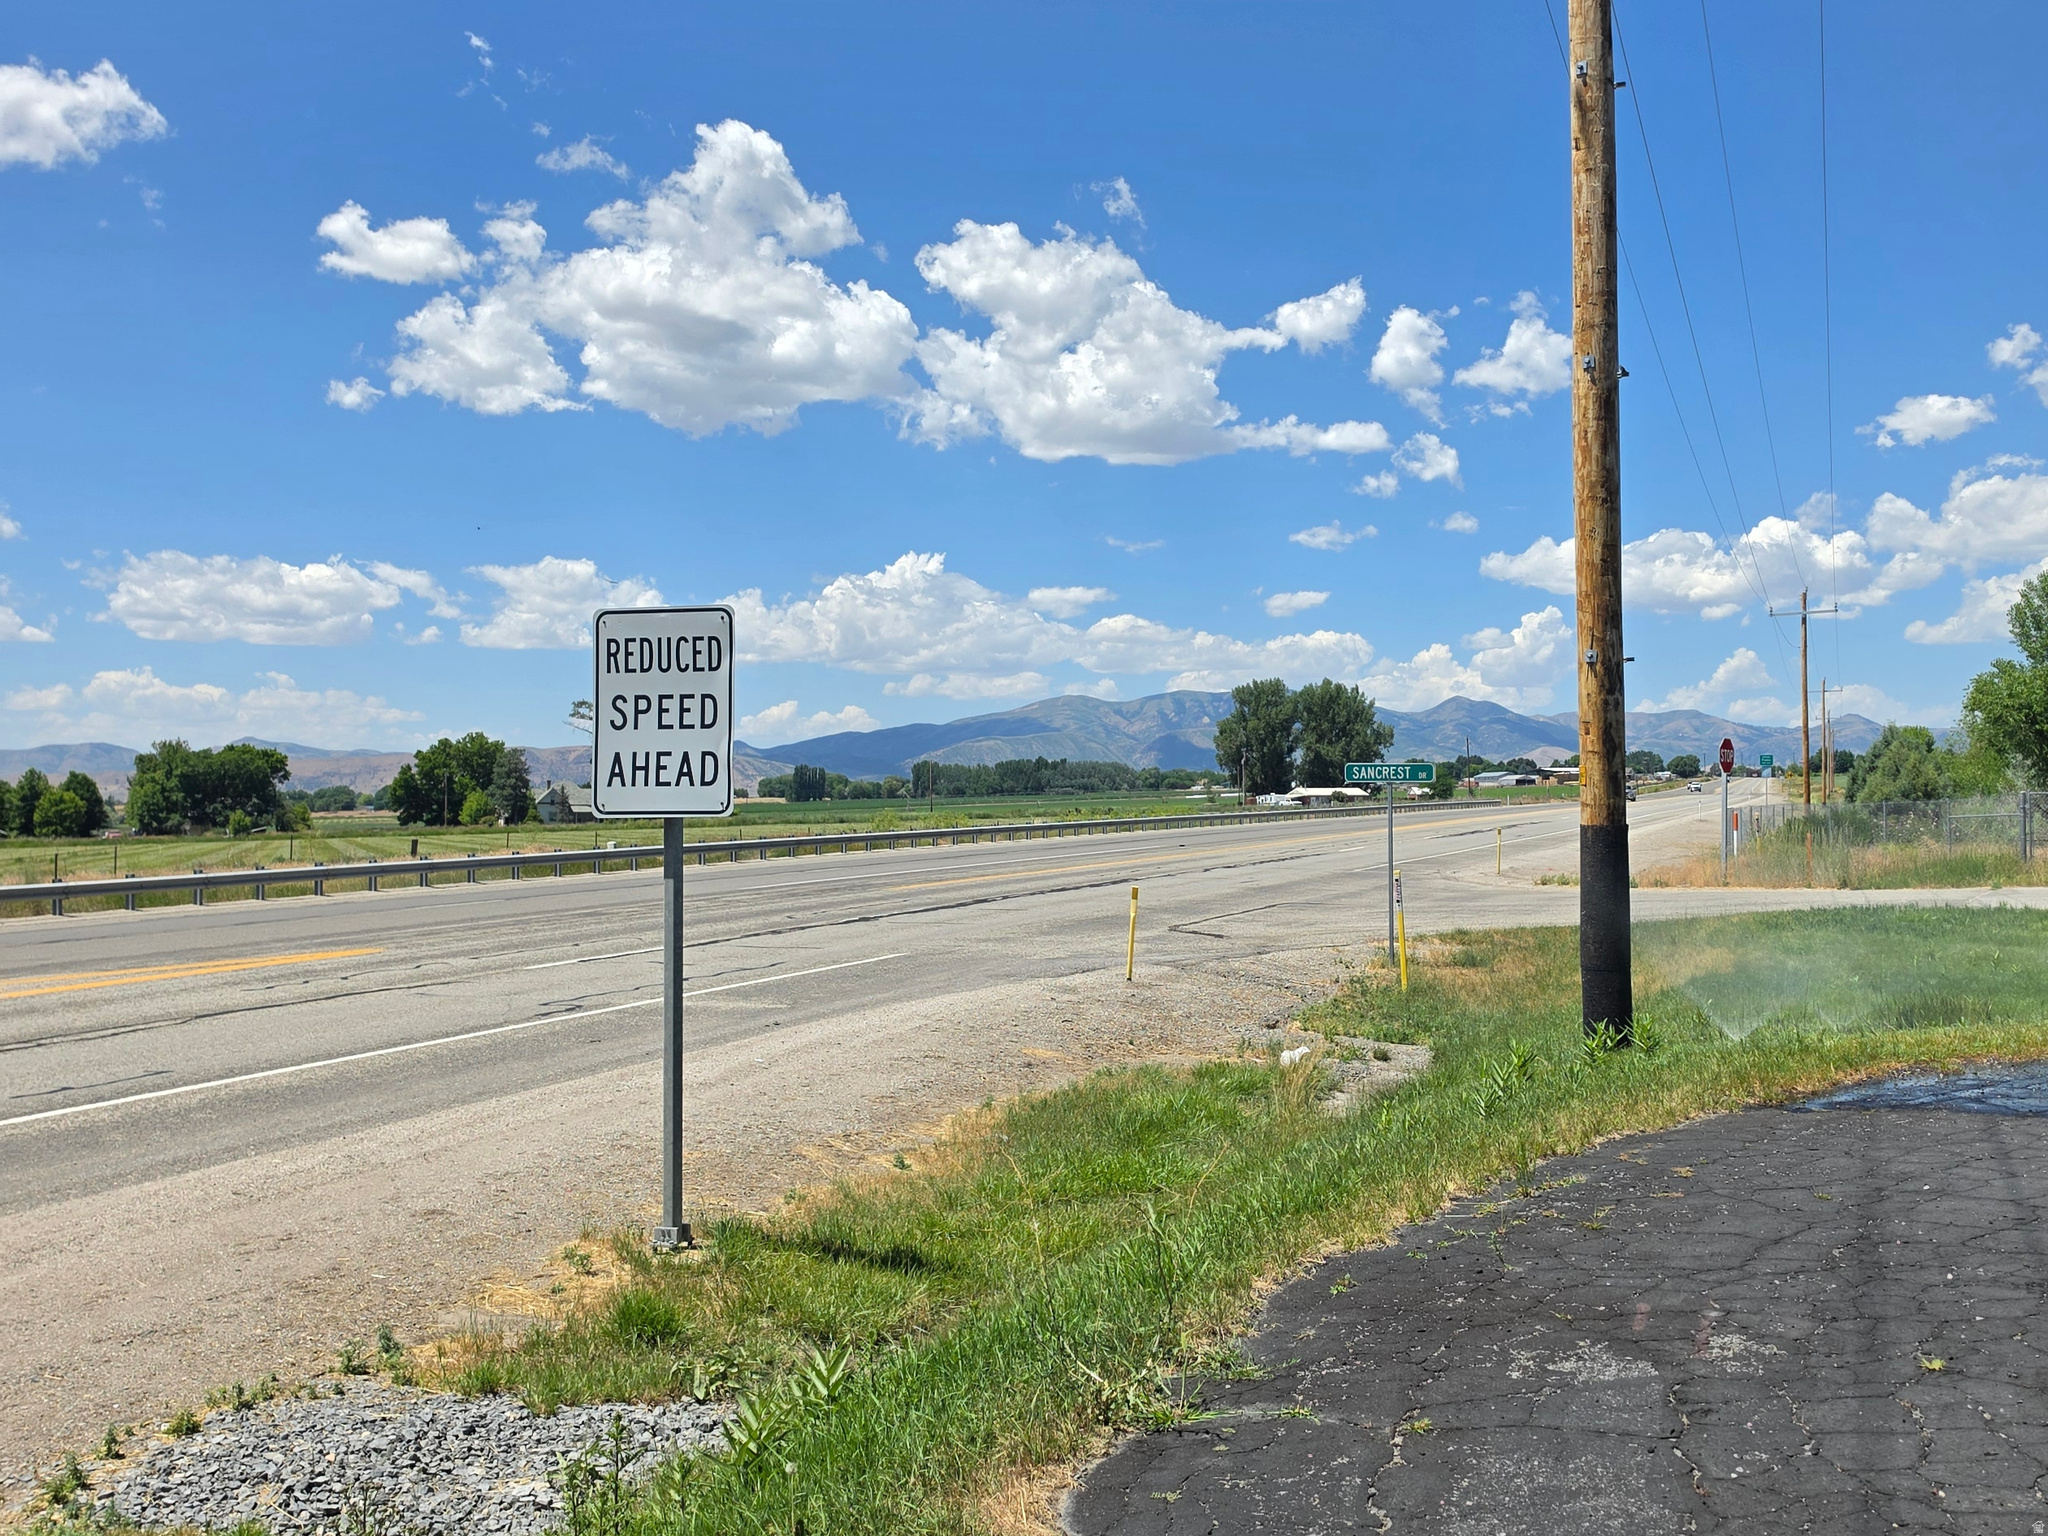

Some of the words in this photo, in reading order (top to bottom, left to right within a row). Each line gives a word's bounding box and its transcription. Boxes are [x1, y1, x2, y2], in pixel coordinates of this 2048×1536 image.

[606, 636, 722, 673] REDUCED
[610, 694, 718, 730] SPEED
[607, 751, 719, 787] AHEAD
[1352, 766, 1411, 779] SANCREST
[1720, 749, 1734, 762] STOP
